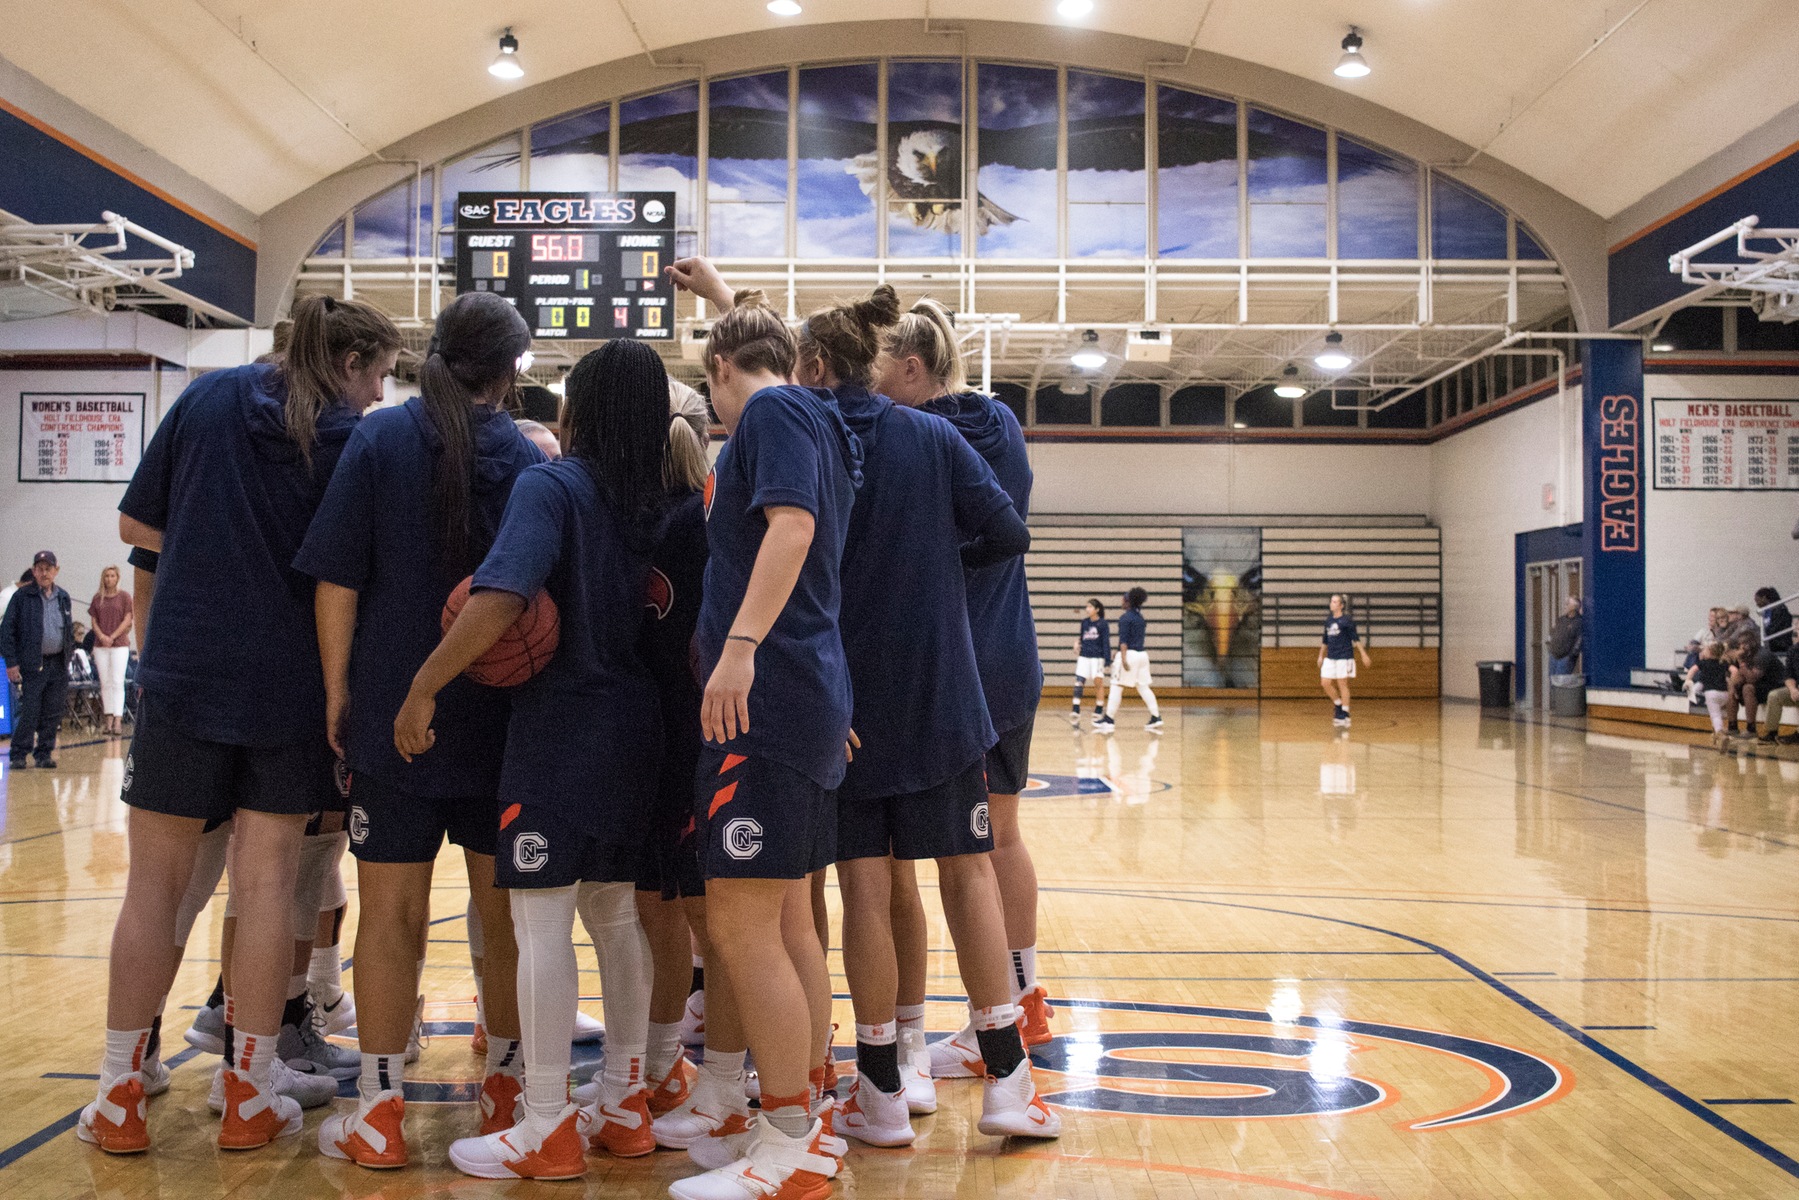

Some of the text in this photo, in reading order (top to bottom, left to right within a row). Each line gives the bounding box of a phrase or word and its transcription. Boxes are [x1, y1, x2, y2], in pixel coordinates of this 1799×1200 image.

[463, 204, 490, 217] SAC
[494, 198, 636, 224] EAGLES
[468, 235, 514, 247] GUEST
[620, 235, 661, 247] HOME
[493, 251, 509, 278] 0
[642, 251, 659, 278] 0
[529, 274, 570, 285] PERIOD
[551, 307, 564, 327] 0
[577, 307, 590, 327] 0
[614, 307, 628, 328] 4
[648, 307, 661, 328] 0
[535, 328, 568, 337] MATCH
[636, 328, 668, 337] POINTS
[32, 402, 134, 412] WOMEN'S BASKETBALL
[1688, 404, 1792, 417] MEN'S BASKETBALL
[1601, 394, 1639, 551] EAGLES
